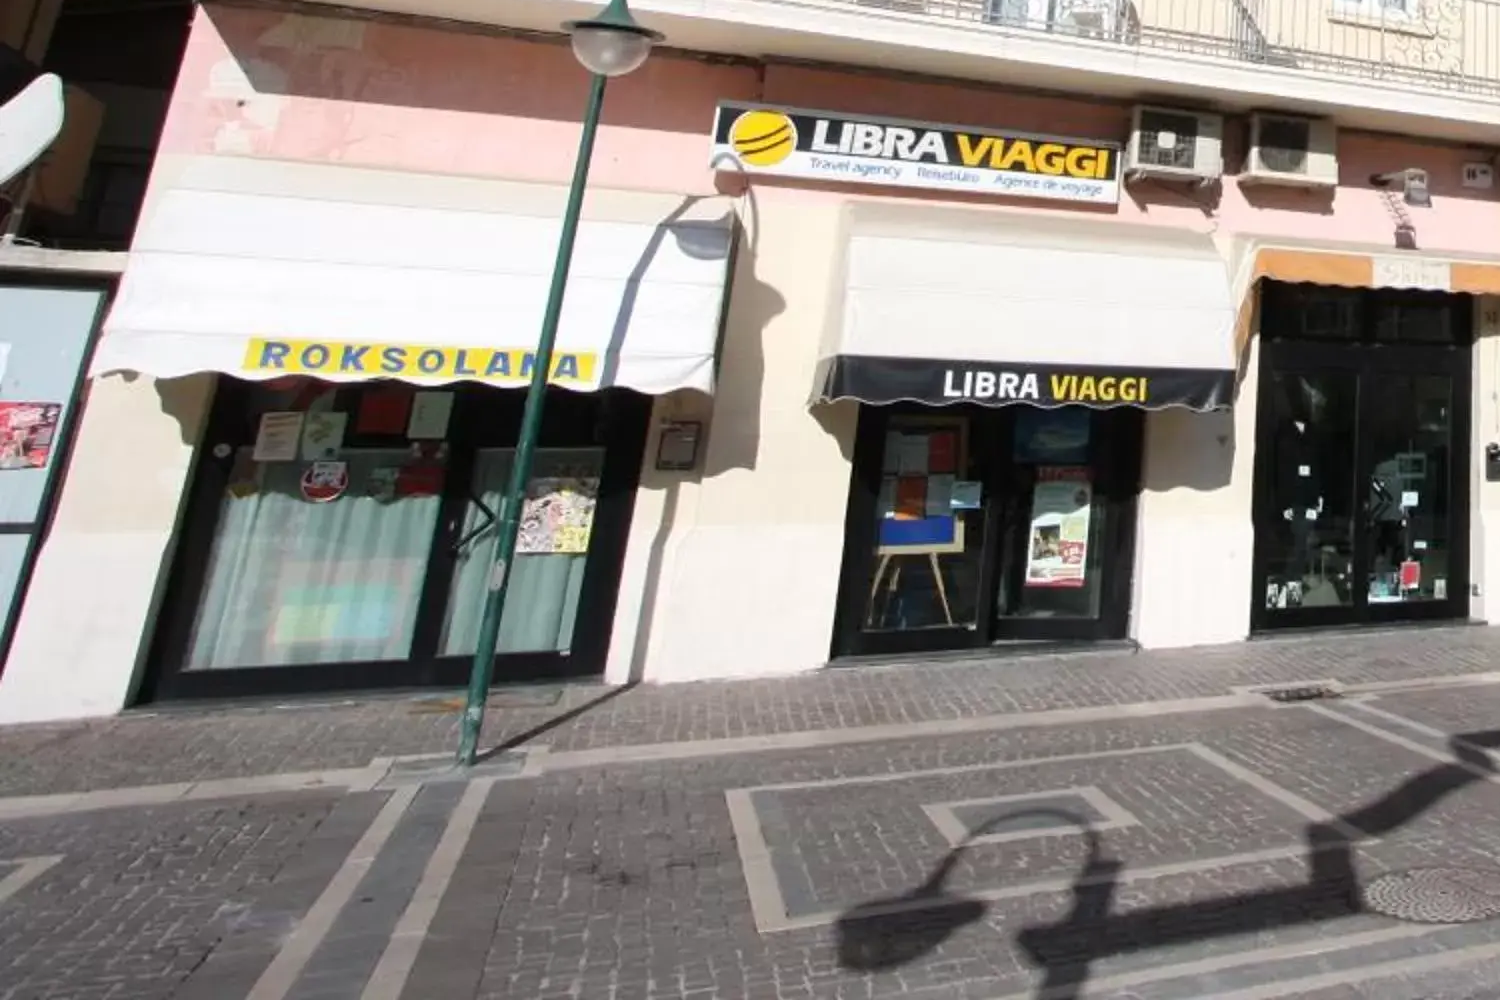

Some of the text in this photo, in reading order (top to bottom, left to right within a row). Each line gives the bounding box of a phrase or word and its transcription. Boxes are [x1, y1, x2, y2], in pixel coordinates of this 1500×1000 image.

[811, 119, 1109, 178] LIBRA VIAGGI
[809, 156, 850, 173] Travel
[852, 161, 903, 180] agency
[943, 369, 1148, 402] LIBRA VIAGGI
